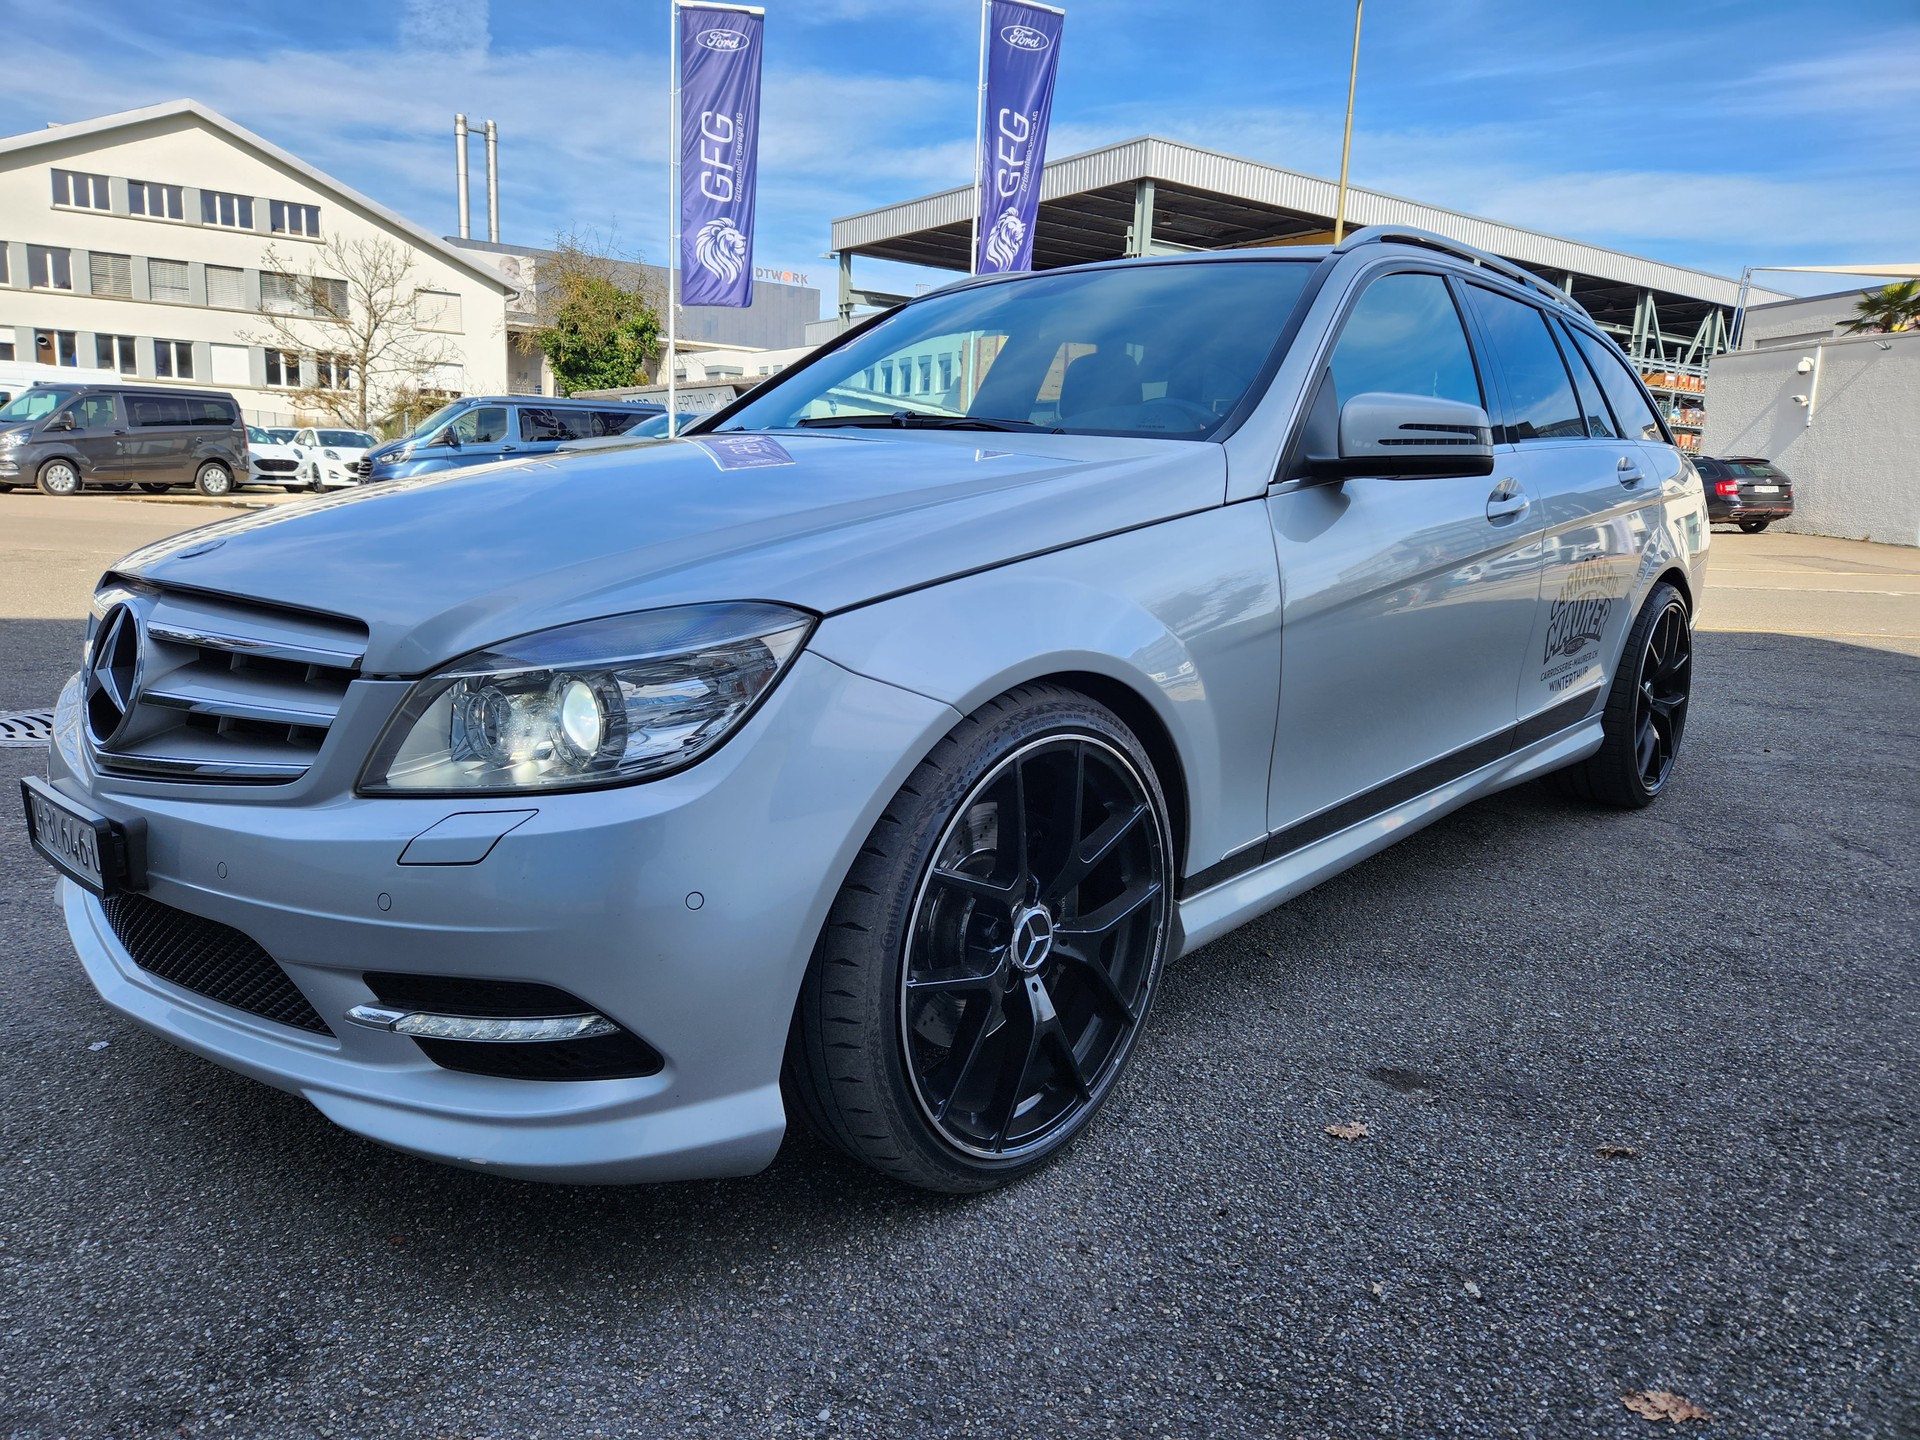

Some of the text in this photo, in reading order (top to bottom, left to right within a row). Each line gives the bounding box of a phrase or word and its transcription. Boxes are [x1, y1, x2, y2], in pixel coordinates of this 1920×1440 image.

[706, 31, 740, 49] Ford
[1009, 27, 1040, 48] Ford
[735, 112, 744, 126] AG
[701, 111, 734, 203] GFG
[997, 108, 1030, 198] GFG
[1543, 590, 1612, 665] MAURER
[1548, 666, 1589, 692] WINTERTHUR
